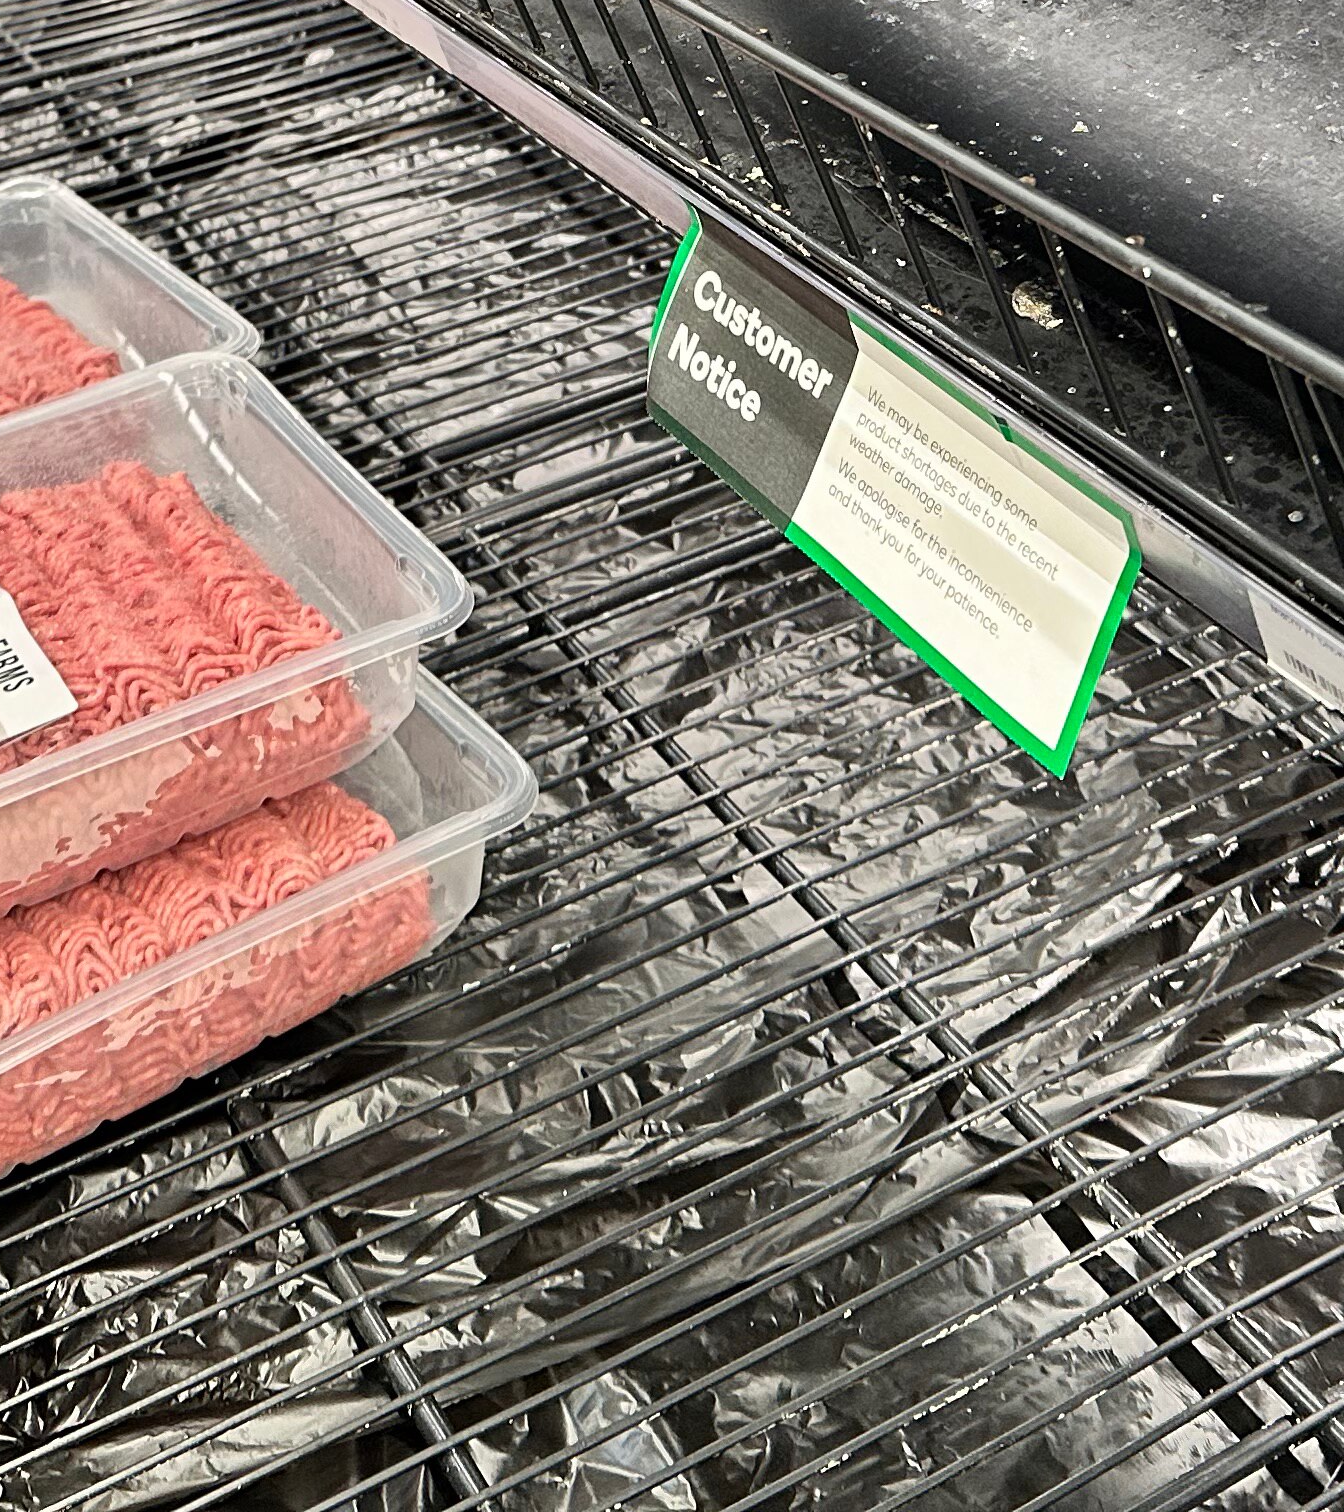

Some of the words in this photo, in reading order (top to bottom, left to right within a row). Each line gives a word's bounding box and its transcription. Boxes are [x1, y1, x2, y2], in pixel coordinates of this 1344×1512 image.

[667, 322, 761, 422] Notice
[693, 270, 834, 399] Customer
[849, 433, 895, 476] weather
[894, 470, 943, 518] damage.
[856, 413, 902, 454] product
[903, 446, 958, 498] shortages
[958, 491, 981, 517] due
[982, 508, 995, 528] to
[996, 519, 1017, 547] the
[1018, 541, 1059, 581] recent
[868, 386, 886, 412] We
[886, 407, 914, 435] may
[913, 422, 929, 446] be
[930, 441, 1003, 506] experiencing
[1005, 498, 1038, 531] some
[828, 484, 852, 508] and
[851, 499, 883, 535] thank
[879, 529, 904, 553] you
[903, 544, 921, 567] for
[917, 561, 946, 589] your
[943, 585, 1000, 639] patience.
[838, 456, 857, 484] We
[857, 479, 910, 528] apologise
[911, 519, 928, 542] for
[927, 534, 947, 560] the
[947, 550, 1033, 633] inconvenience
